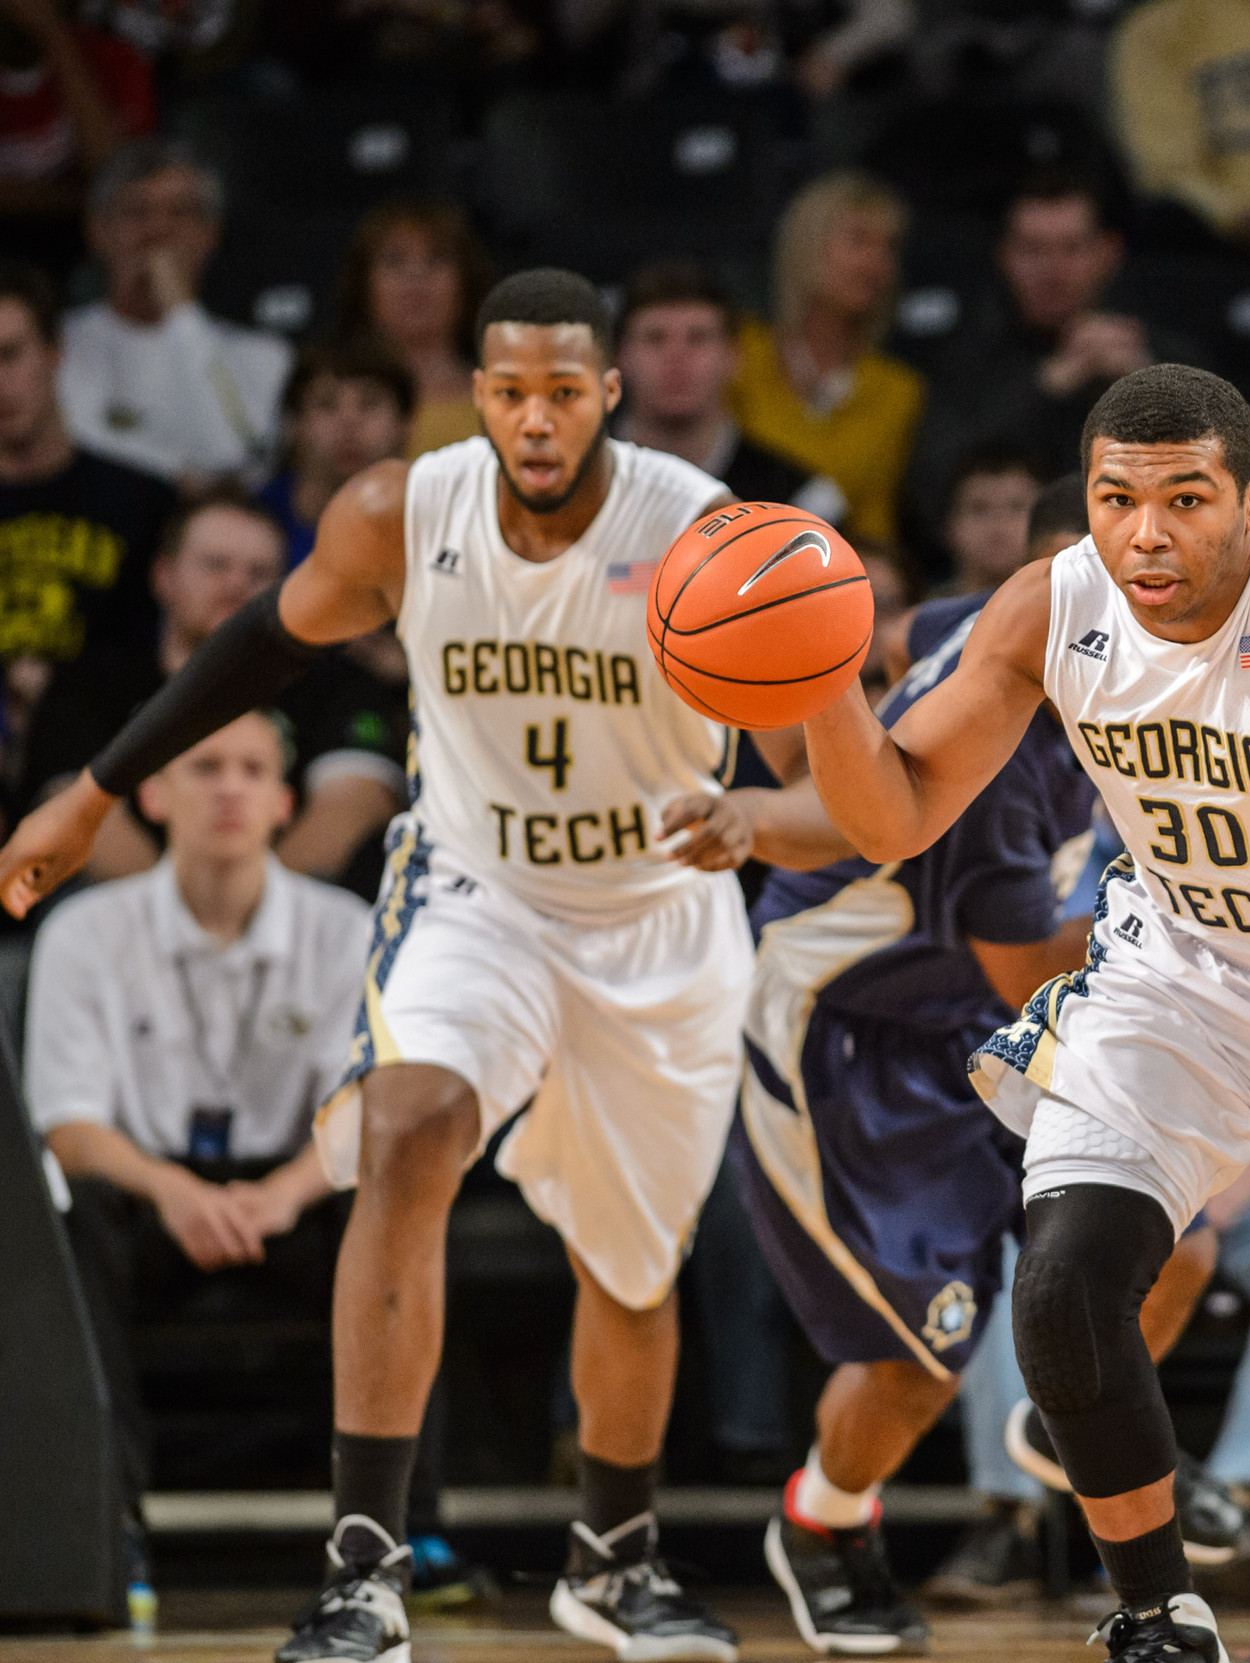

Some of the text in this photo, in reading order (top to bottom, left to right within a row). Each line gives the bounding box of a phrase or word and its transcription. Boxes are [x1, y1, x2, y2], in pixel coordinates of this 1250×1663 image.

[441, 639, 643, 706] GEORGIA
[1068, 642, 1108, 662] RUSSELL
[525, 716, 573, 792] 4
[487, 801, 648, 867] TECH
[1136, 795, 1250, 869] 30
[1113, 926, 1143, 950] RUSSELL
